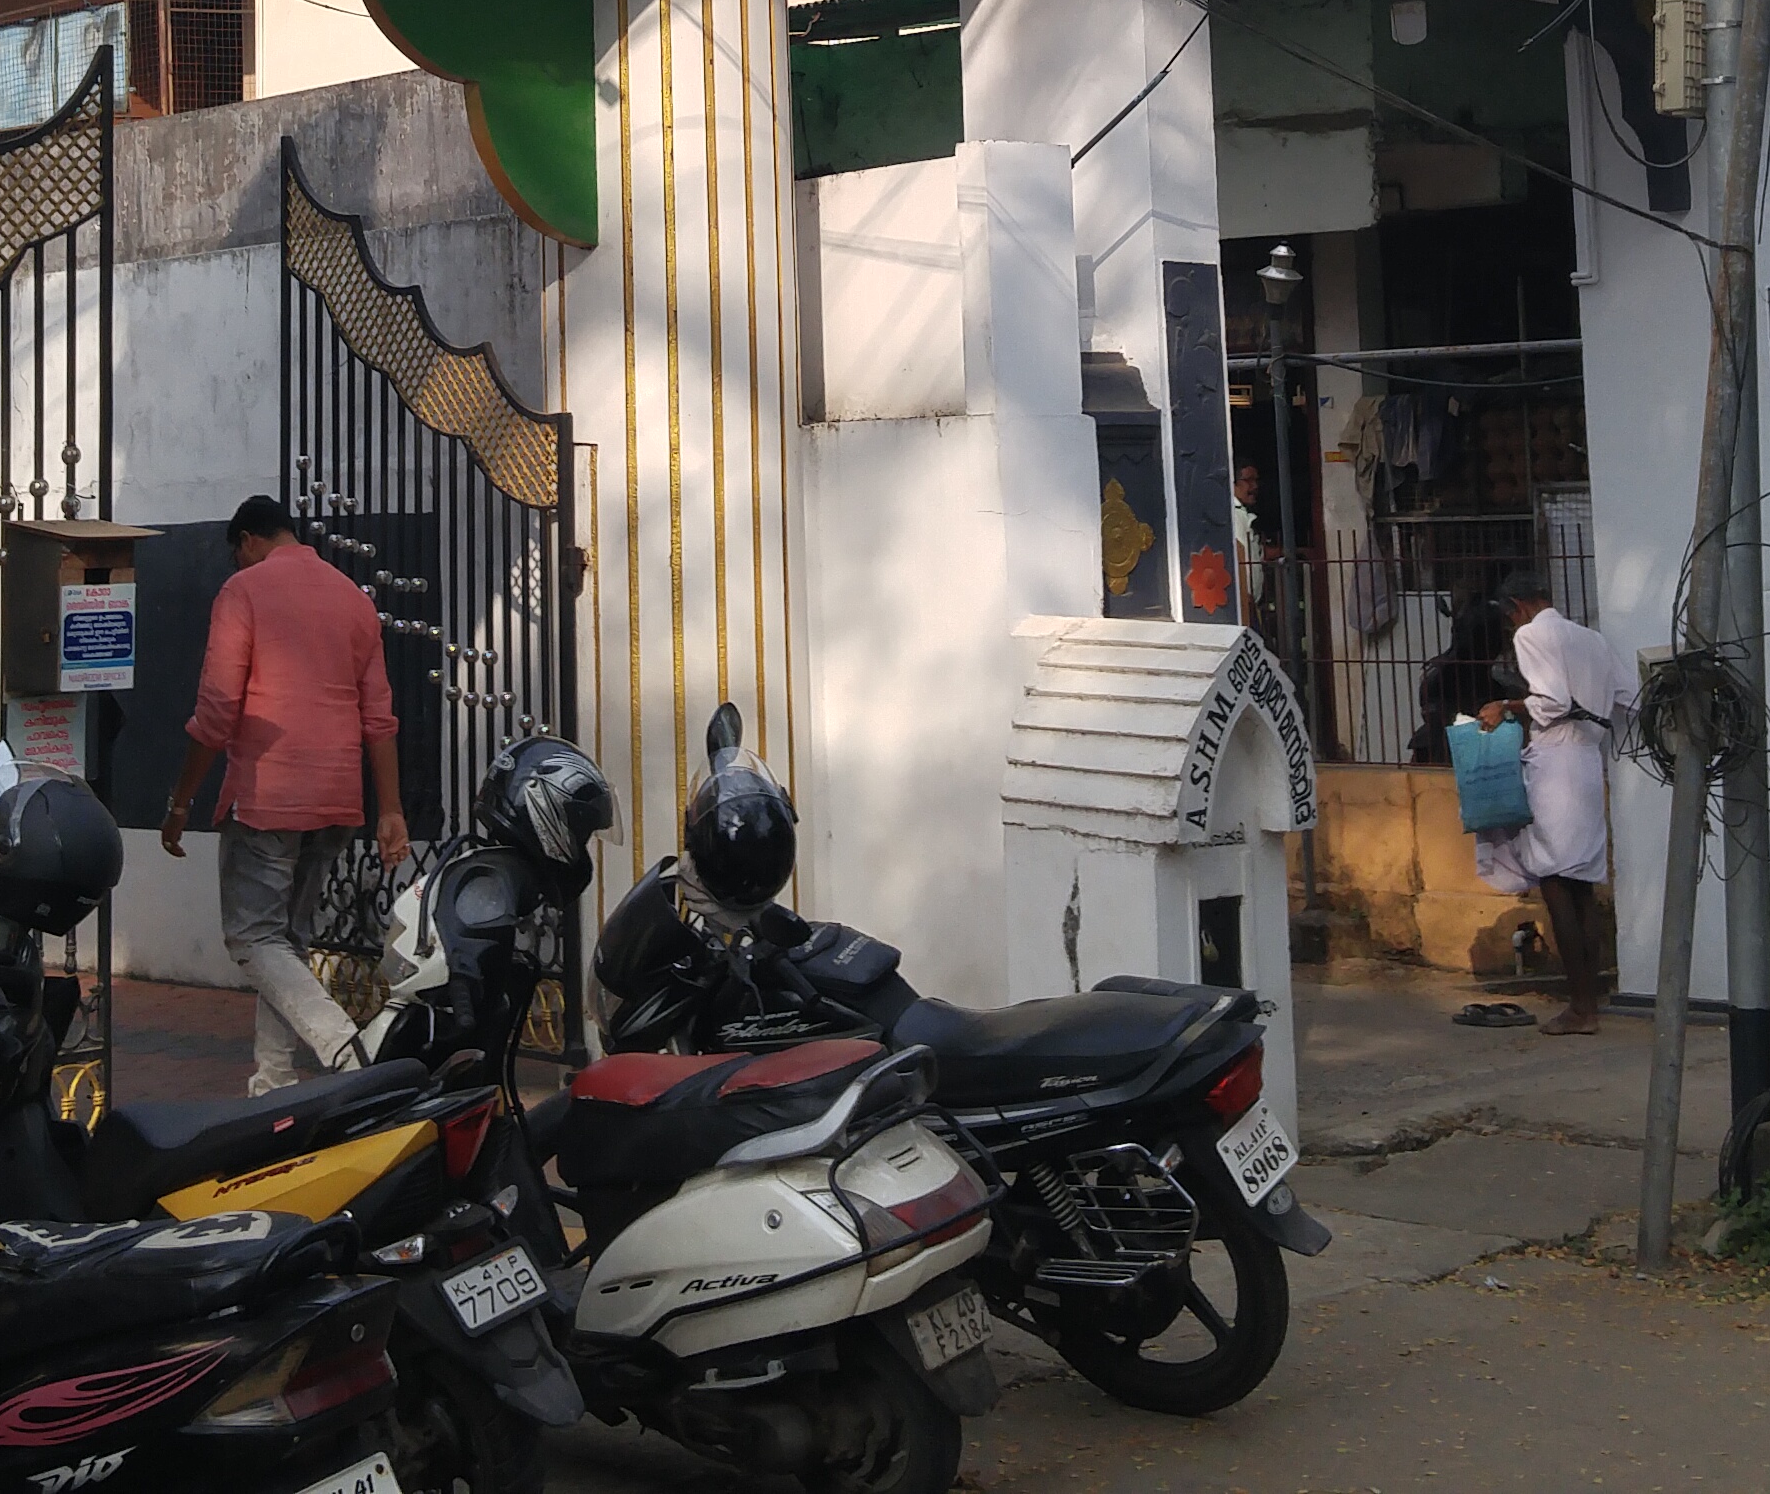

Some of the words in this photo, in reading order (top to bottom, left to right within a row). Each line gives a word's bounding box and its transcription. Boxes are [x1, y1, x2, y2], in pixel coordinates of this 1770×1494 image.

[1240, 1138, 1294, 1199] 8968
[448, 1278, 479, 1302] KL
[457, 1265, 540, 1327] 7709
[678, 1270, 781, 1297] Activa
[926, 1303, 957, 1336] KL
